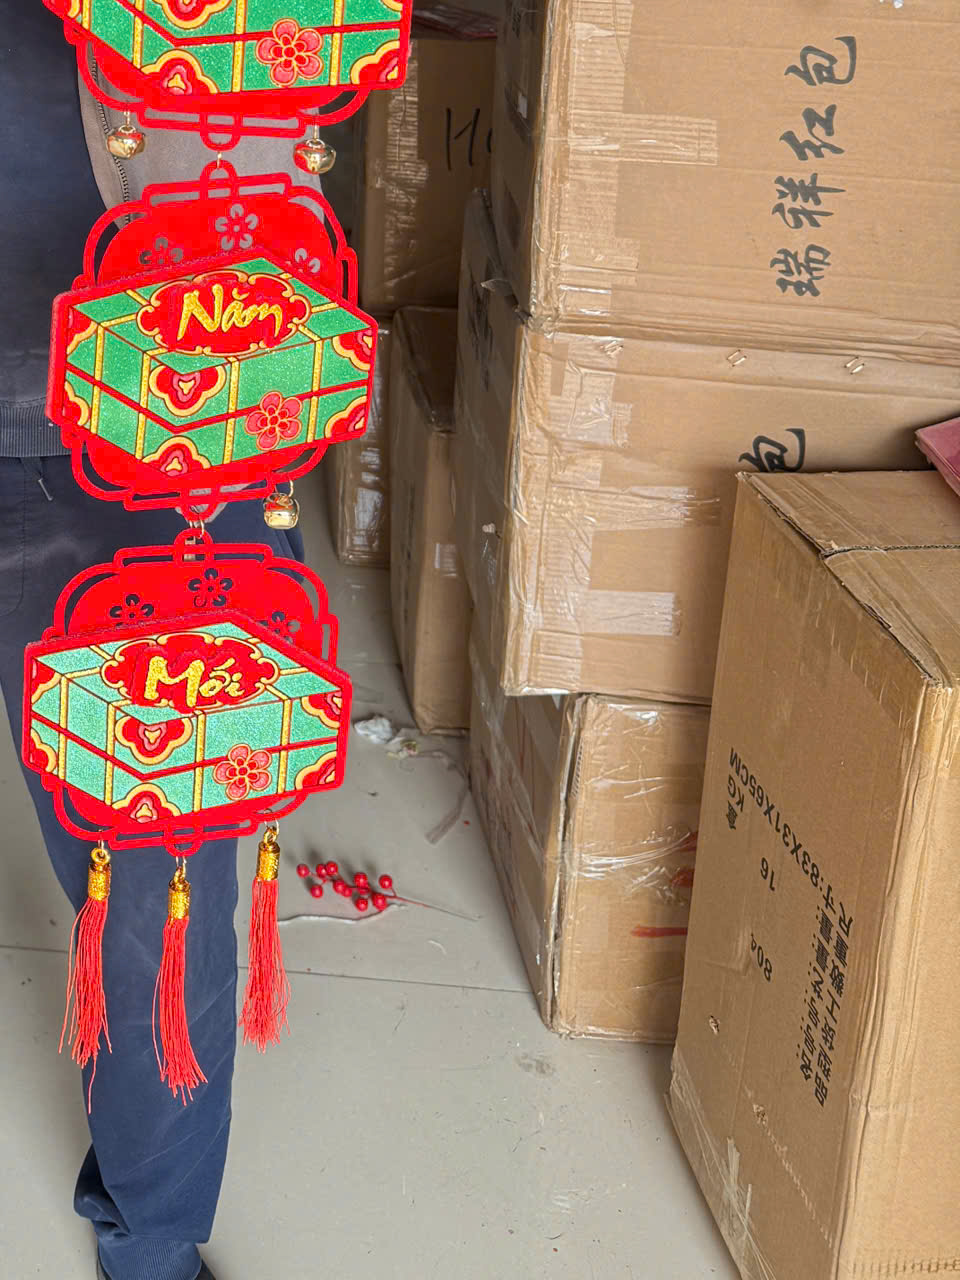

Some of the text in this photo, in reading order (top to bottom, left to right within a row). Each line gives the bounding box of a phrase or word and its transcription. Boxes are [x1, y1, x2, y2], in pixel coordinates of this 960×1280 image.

[770, 35, 857, 297] 瑞祥红包
[177, 283, 282, 341] Năm
[144, 656, 245, 707] Mới
[728, 774, 745, 812] KG
[760, 857, 775, 891] 16
